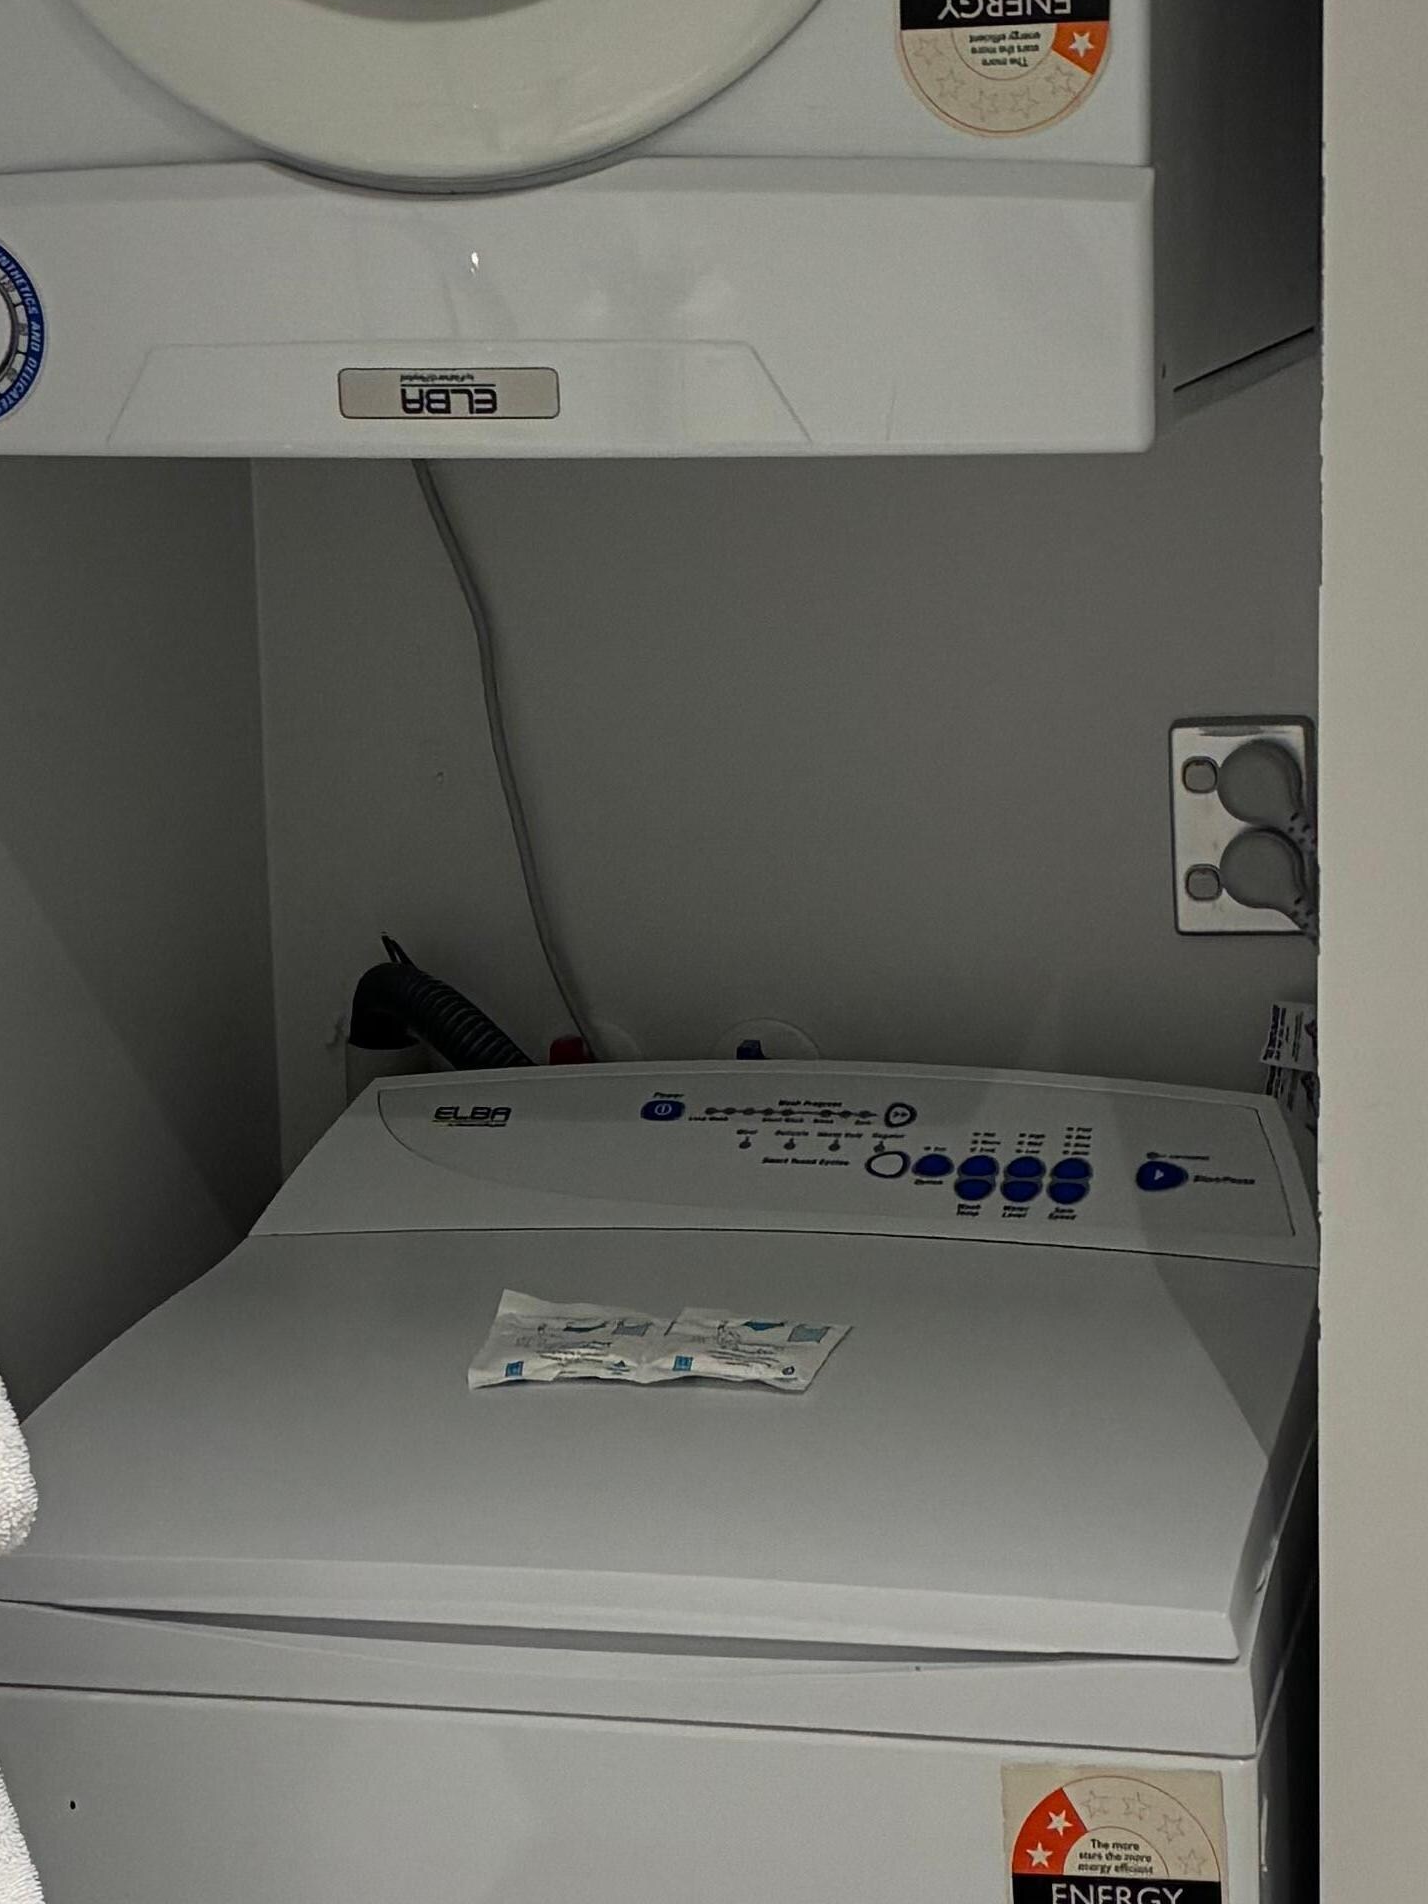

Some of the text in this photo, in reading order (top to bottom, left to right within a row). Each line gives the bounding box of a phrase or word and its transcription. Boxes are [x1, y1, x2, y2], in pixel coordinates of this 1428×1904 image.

[969, 30, 1041, 43] energy efficient
[971, 46, 997, 54] more
[981, 57, 1028, 67] The more
[31, 322, 42, 352] AND
[400, 389, 497, 414] ELBA
[434, 1106, 512, 1122] ELBA
[1090, 1839, 1140, 1851] The more
[1079, 1852, 1152, 1863] stars the more
[1077, 1863, 1154, 1874] energy efficient
